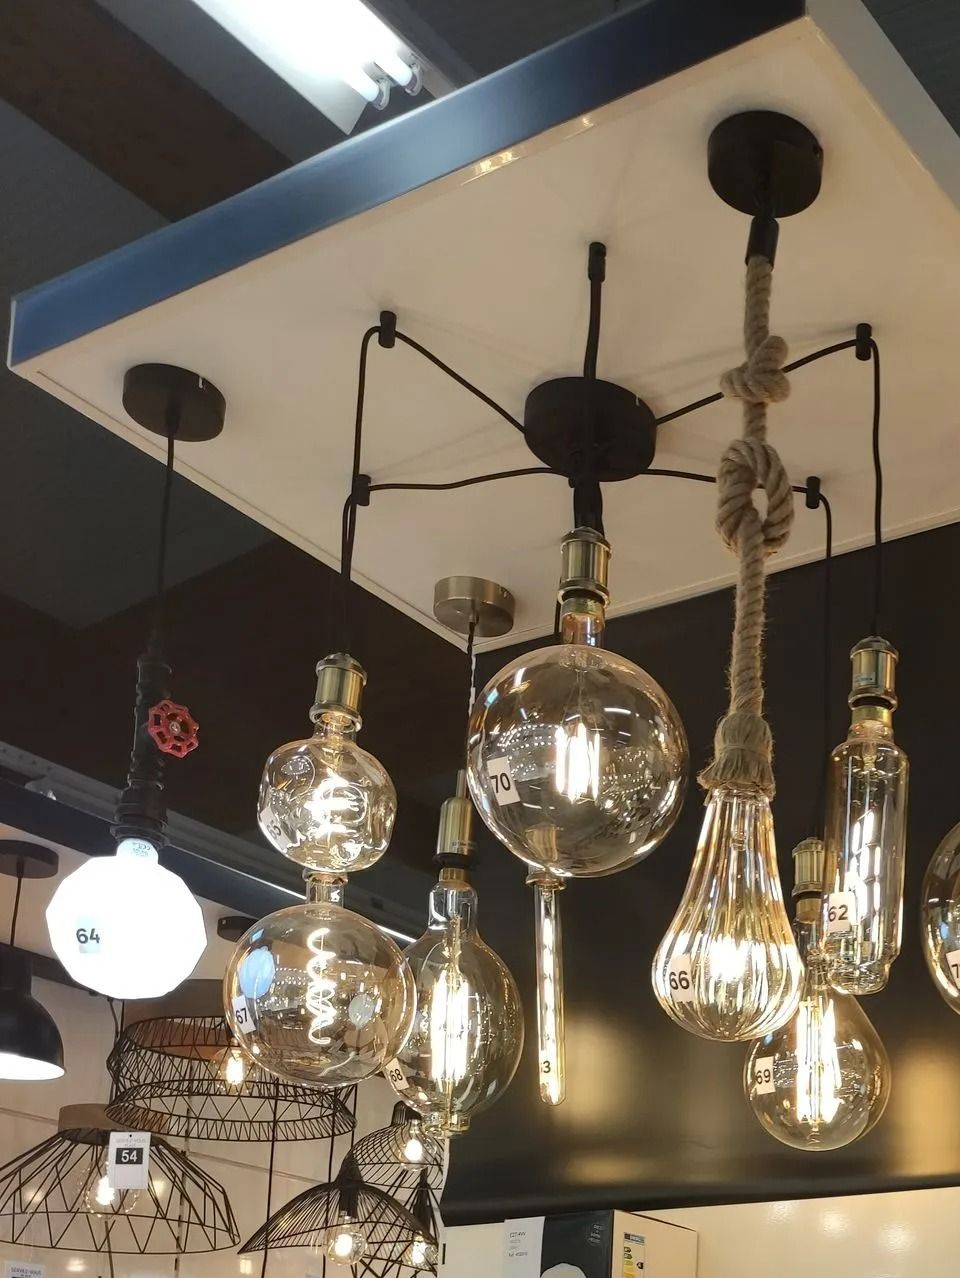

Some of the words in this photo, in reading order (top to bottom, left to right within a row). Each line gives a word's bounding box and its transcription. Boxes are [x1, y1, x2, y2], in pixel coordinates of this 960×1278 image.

[490, 773, 510, 793] 70
[828, 905, 848, 921] 62
[76, 927, 101, 945] 64
[669, 971, 690, 990] 66
[235, 1007, 249, 1025] 67
[389, 1068, 403, 1083] 68
[756, 1069, 771, 1084] 69
[121, 1151, 138, 1163] 54
